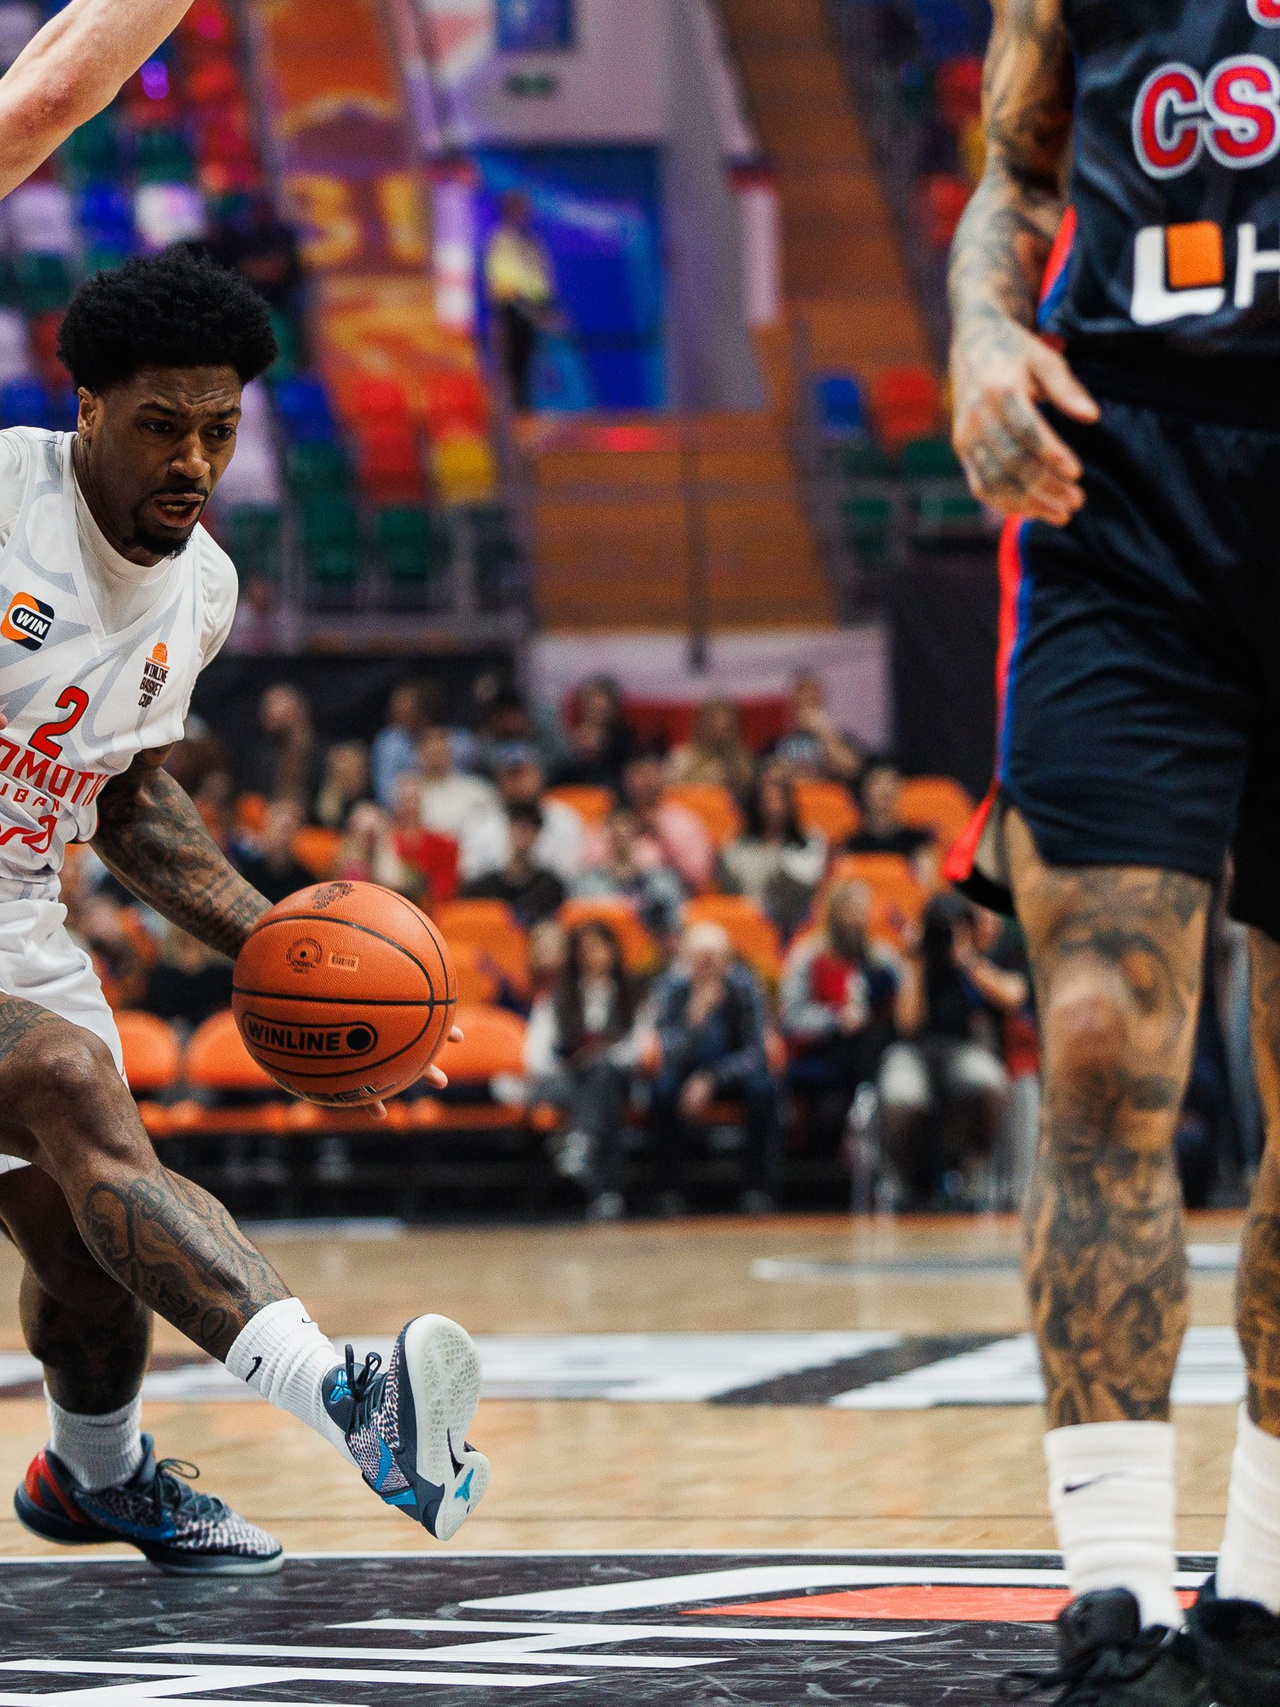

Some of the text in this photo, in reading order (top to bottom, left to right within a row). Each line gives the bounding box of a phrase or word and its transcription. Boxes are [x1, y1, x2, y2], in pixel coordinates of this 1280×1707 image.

[16, 610, 49, 636] WIN
[139, 676, 163, 697] BASKET
[138, 693, 153, 708] CUP
[28, 686, 90, 761] 2
[248, 1019, 342, 1052] WINLINE
